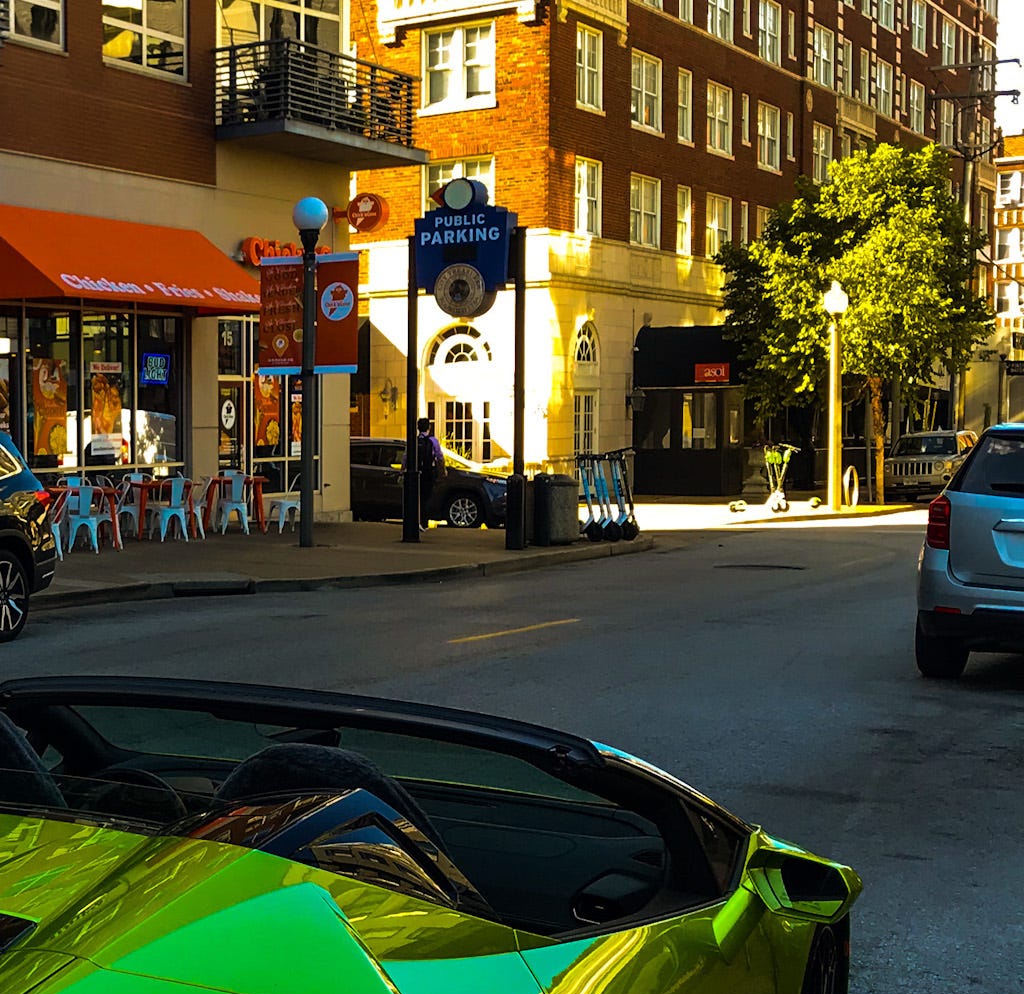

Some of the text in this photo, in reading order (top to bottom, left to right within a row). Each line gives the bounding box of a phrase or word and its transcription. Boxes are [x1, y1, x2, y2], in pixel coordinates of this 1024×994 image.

[434, 213, 486, 228] PUBLIC
[420, 227, 500, 246] PARKING
[60, 273, 147, 295] Chicken
[152, 281, 205, 299] Fries
[221, 331, 233, 346] 15
[146, 356, 166, 368] BUD
[144, 368, 168, 381] LIGHT
